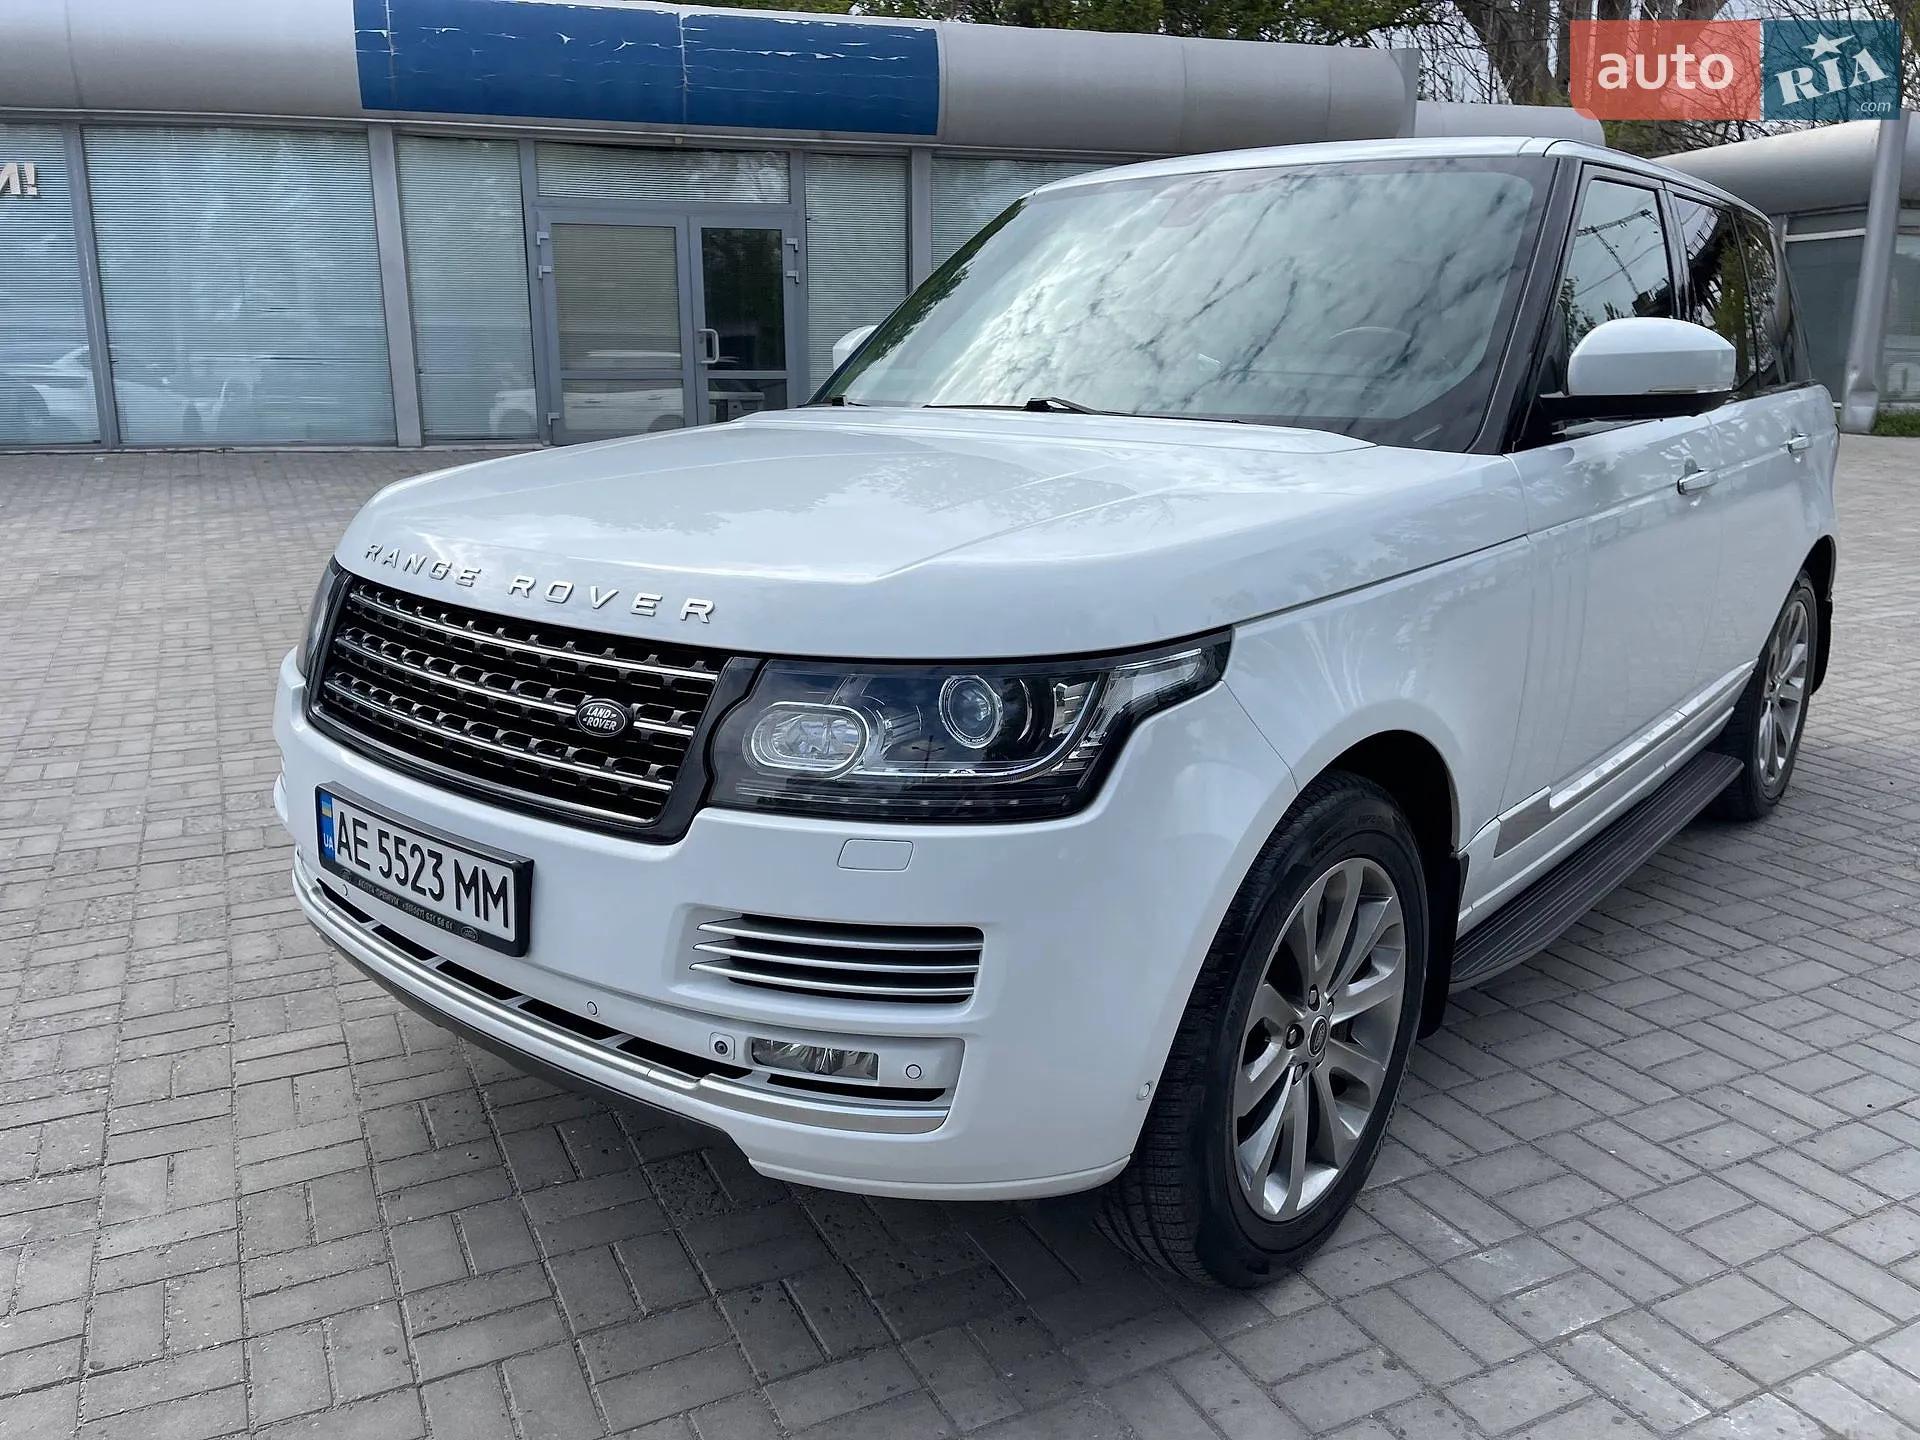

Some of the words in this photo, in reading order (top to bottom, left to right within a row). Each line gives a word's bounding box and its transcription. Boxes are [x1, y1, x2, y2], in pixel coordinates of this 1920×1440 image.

[365, 543, 482, 587] RANGE
[507, 575, 715, 624] ROVER
[586, 706, 612, 719] LAND
[586, 716, 617, 731] ROVER
[323, 832, 335, 851] UA
[337, 811, 371, 872] AE
[377, 828, 445, 902] 5523
[454, 858, 509, 929] MM
